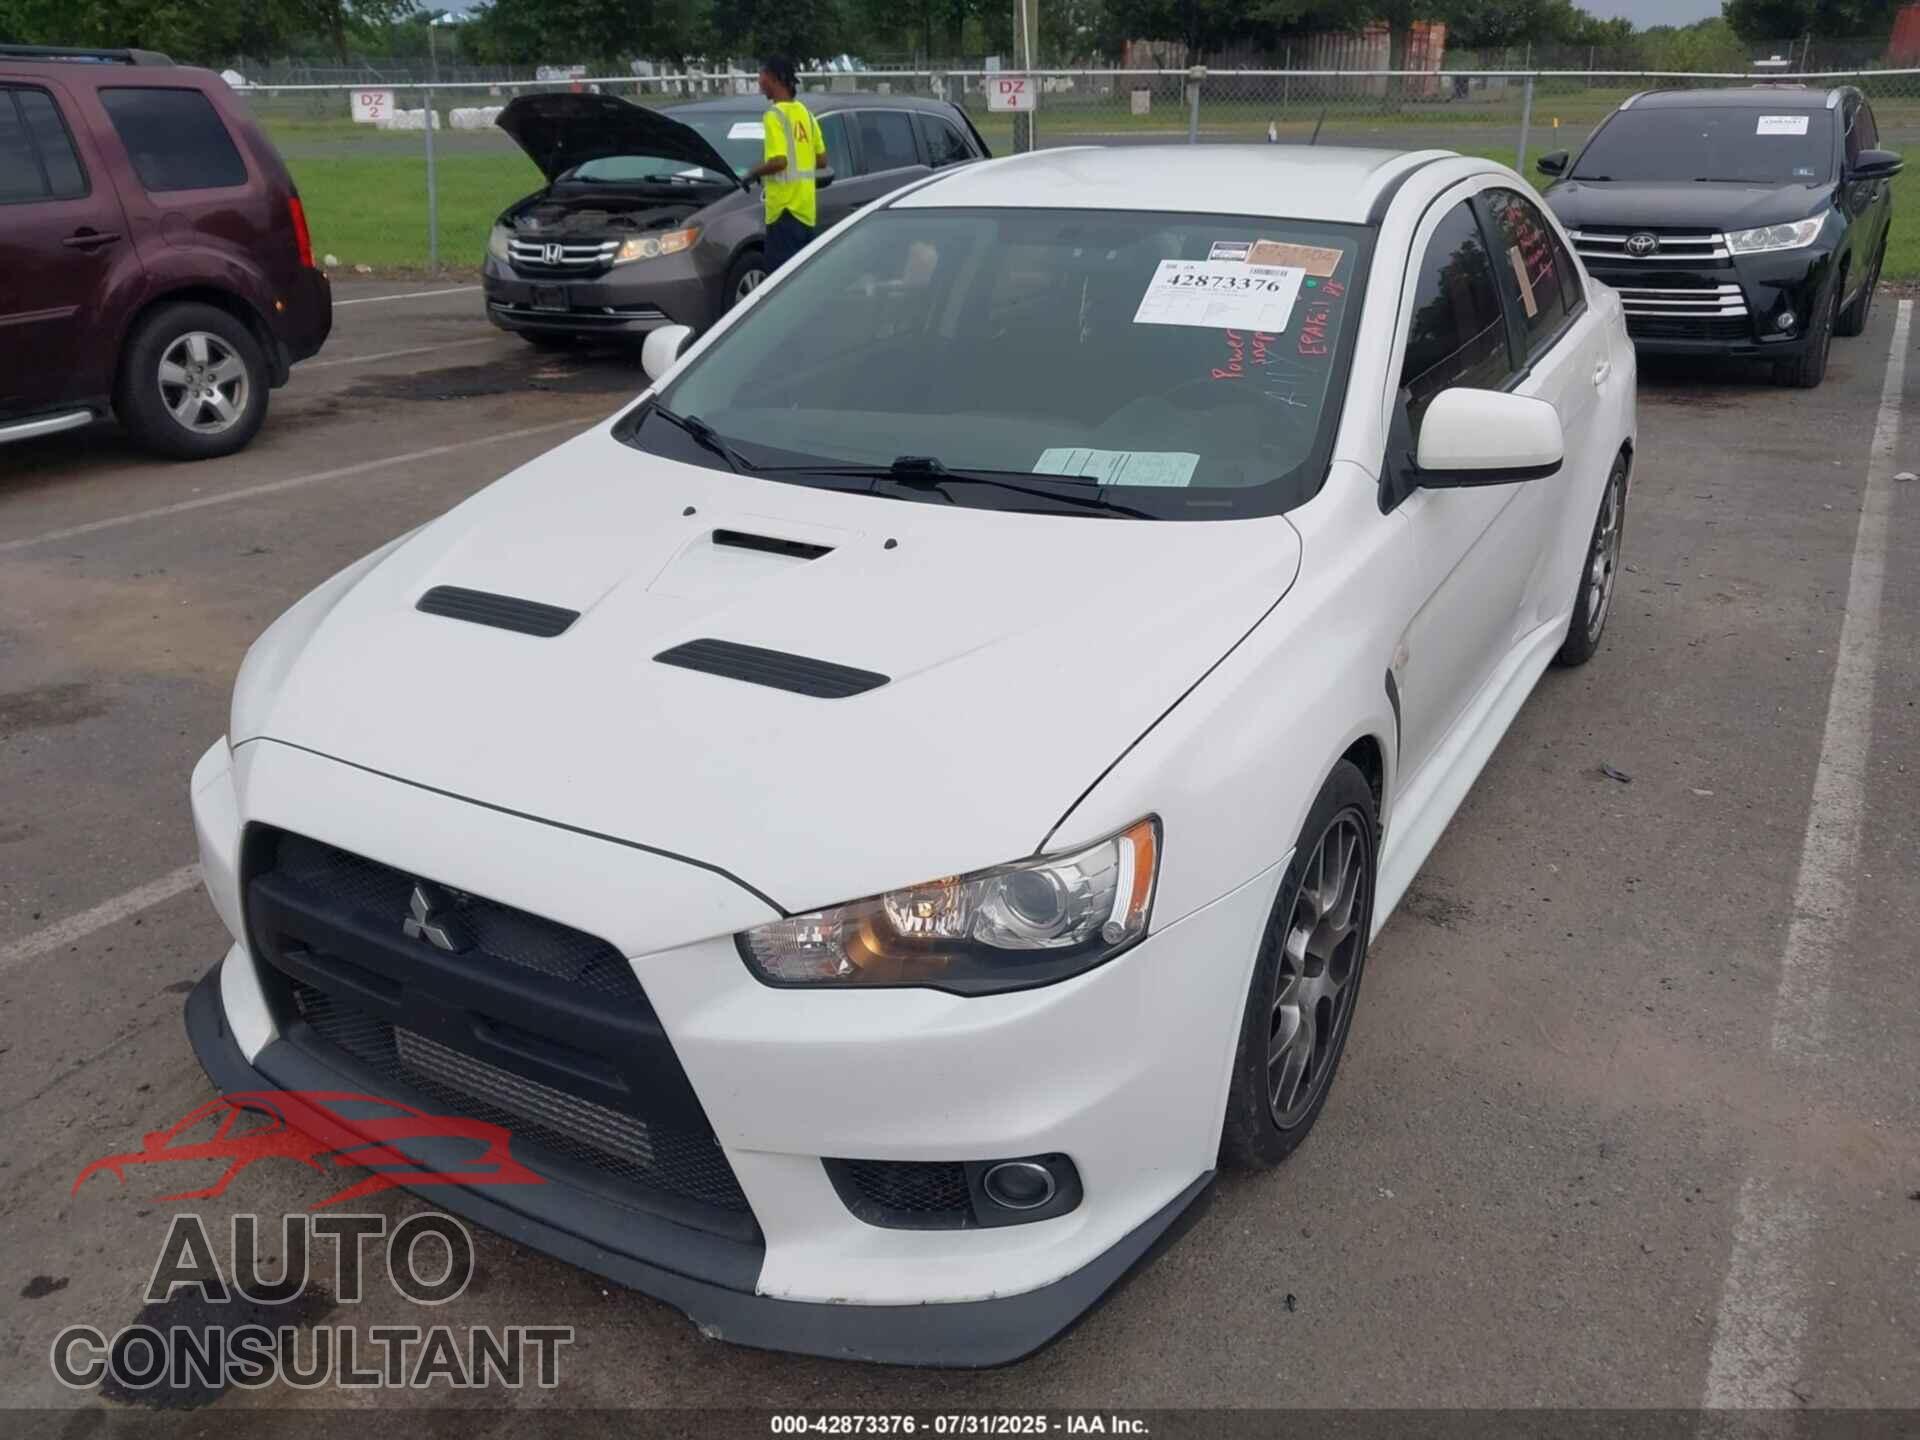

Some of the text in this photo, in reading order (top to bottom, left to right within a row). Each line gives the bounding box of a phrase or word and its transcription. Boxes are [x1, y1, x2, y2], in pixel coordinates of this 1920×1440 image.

[1000, 80, 1024, 94] DZ
[361, 94, 384, 106] DZ
[1007, 95, 1017, 107] 4
[369, 106, 380, 118] 2
[1166, 273, 1281, 294] 42873376
